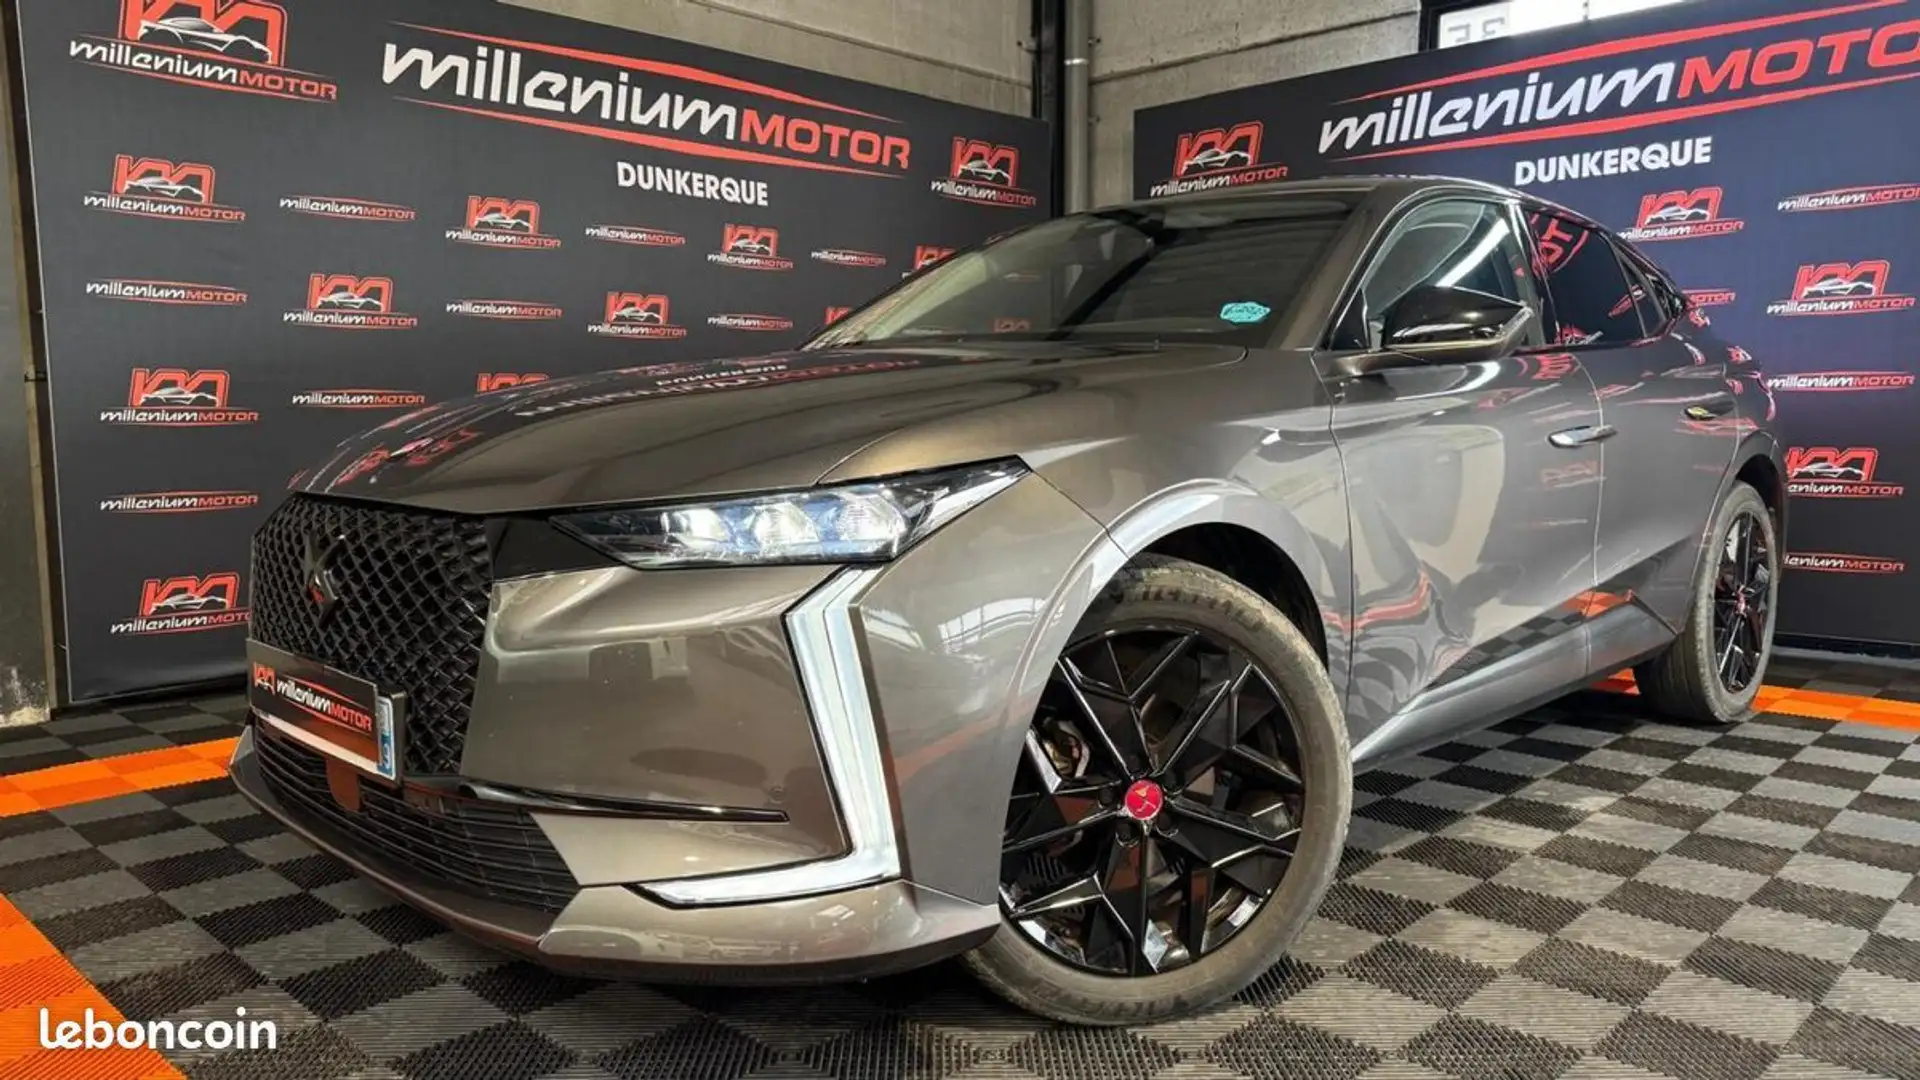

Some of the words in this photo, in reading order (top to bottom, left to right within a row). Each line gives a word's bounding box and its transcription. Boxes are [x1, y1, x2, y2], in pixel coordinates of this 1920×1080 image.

[1318, 20, 1920, 154] milleniumMOTO
[617, 161, 768, 206] DUNKERQUE
[1514, 137, 1713, 186] DUNKERQUE
